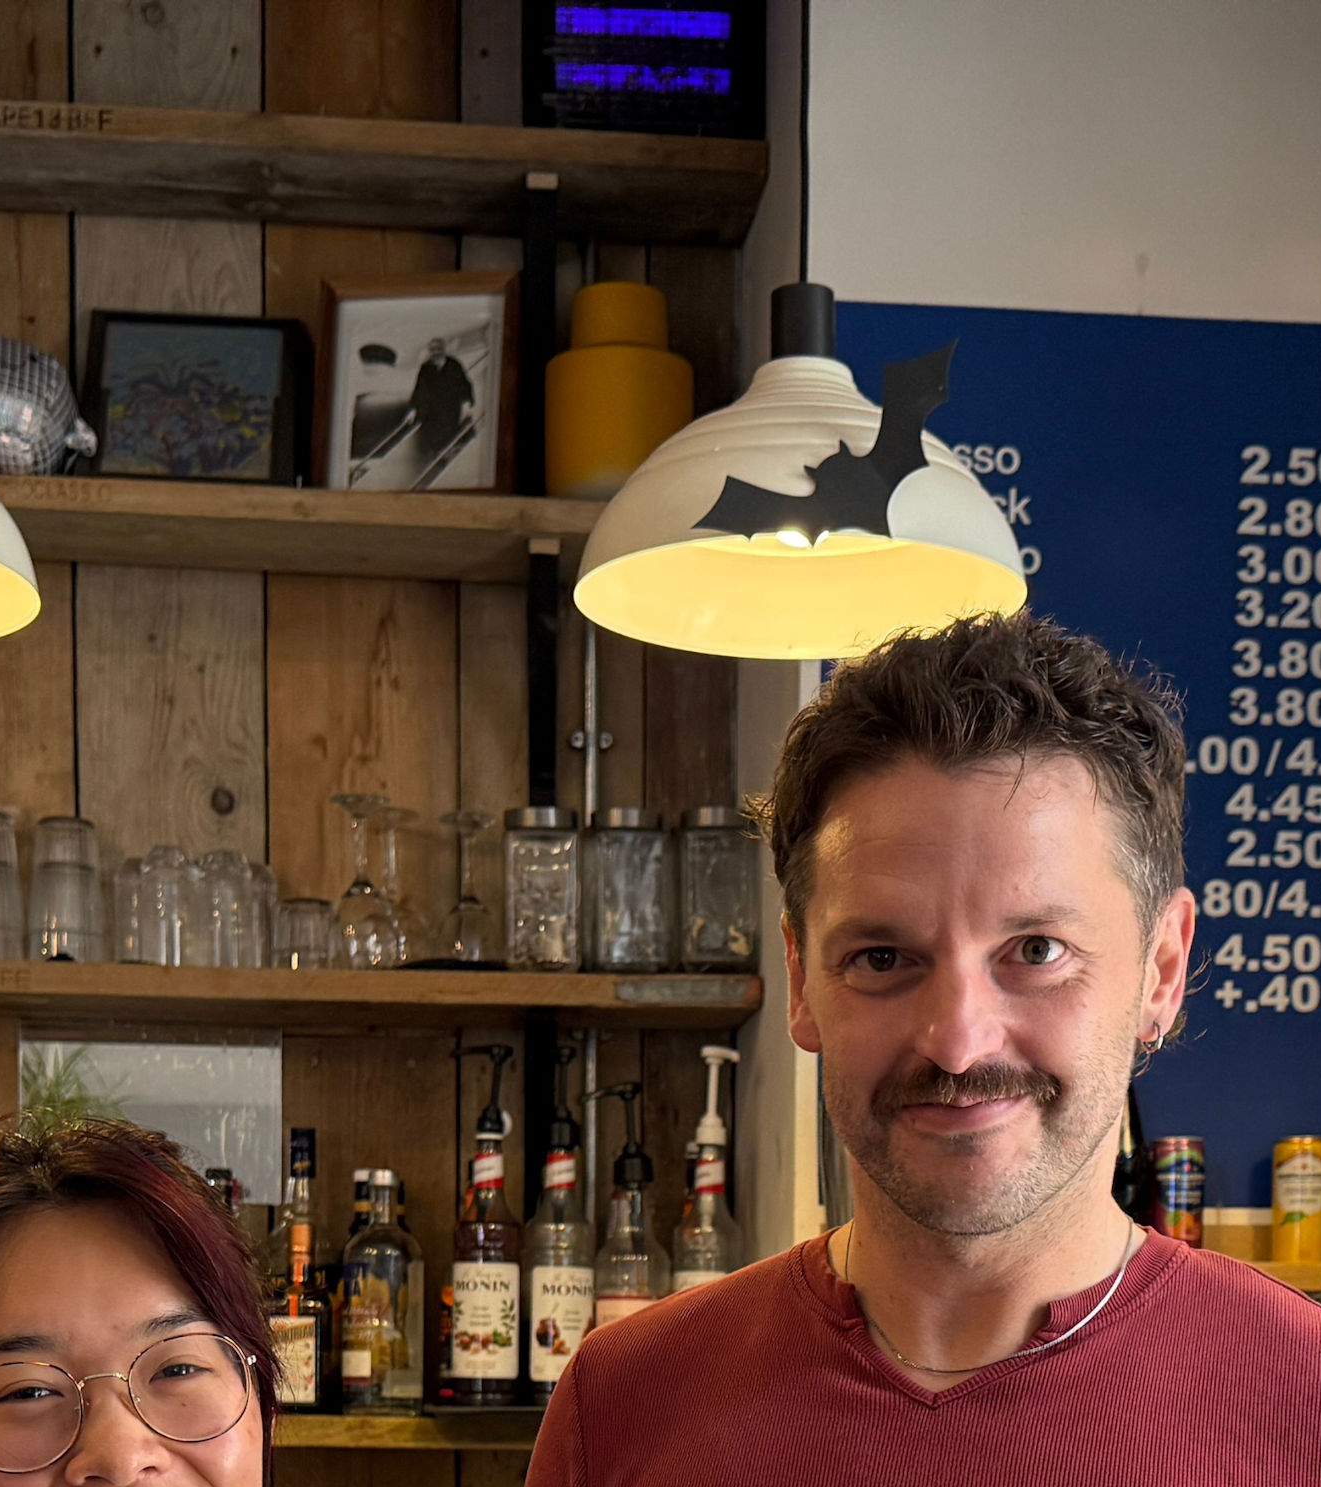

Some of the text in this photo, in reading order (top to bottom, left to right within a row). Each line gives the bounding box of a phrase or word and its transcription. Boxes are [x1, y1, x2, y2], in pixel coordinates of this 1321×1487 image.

[1215, 934, 1321, 973] 4.50
[1215, 974, 1320, 1013] +.40
[455, 1279, 511, 1292] MONIN
